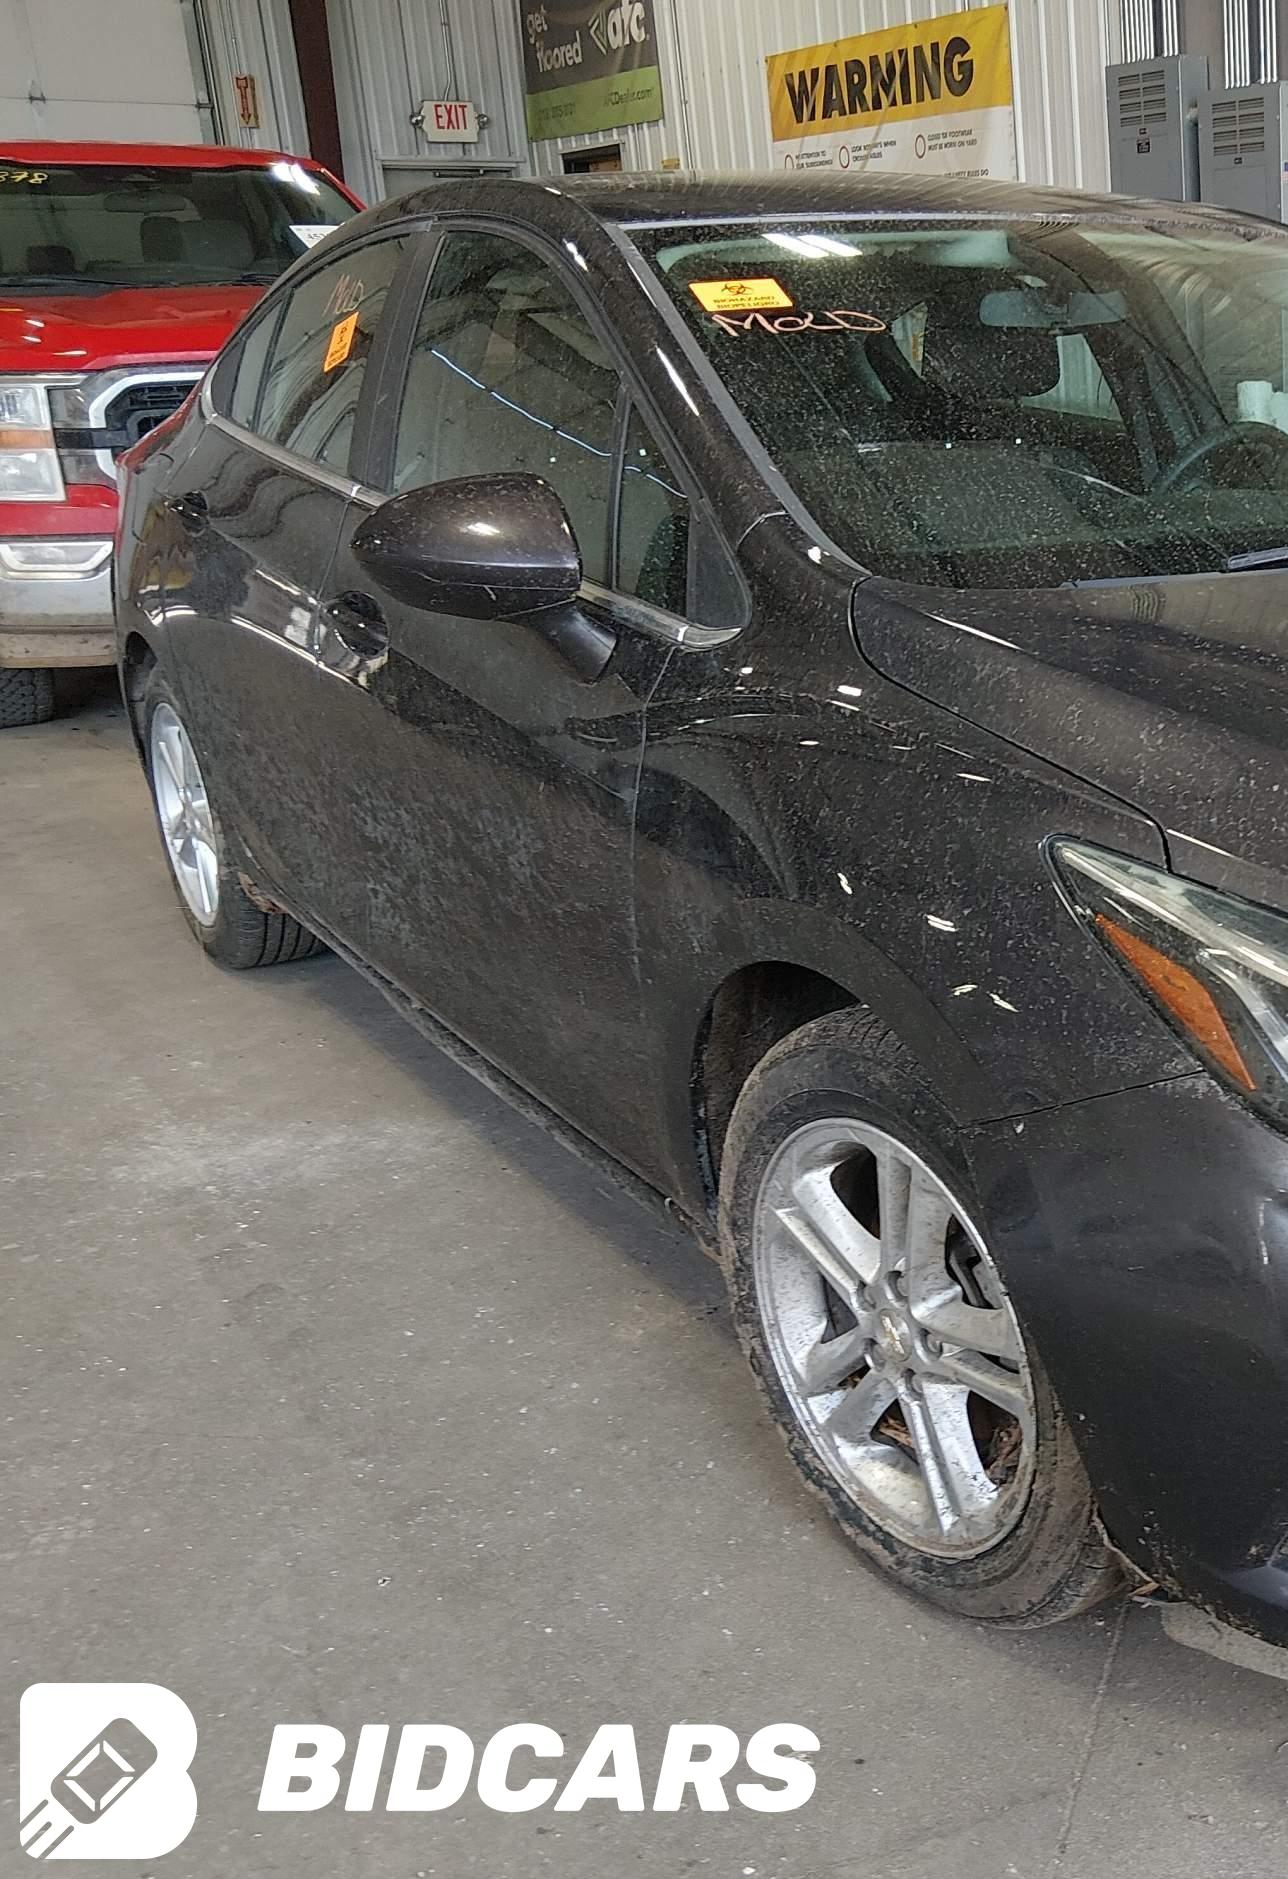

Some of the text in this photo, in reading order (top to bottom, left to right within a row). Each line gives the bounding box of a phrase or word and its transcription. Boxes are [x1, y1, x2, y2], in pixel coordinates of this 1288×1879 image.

[526, 4, 548, 44] get
[536, 30, 583, 73] floored
[784, 36, 974, 124] WARNING
[434, 104, 468, 130] EXIT
